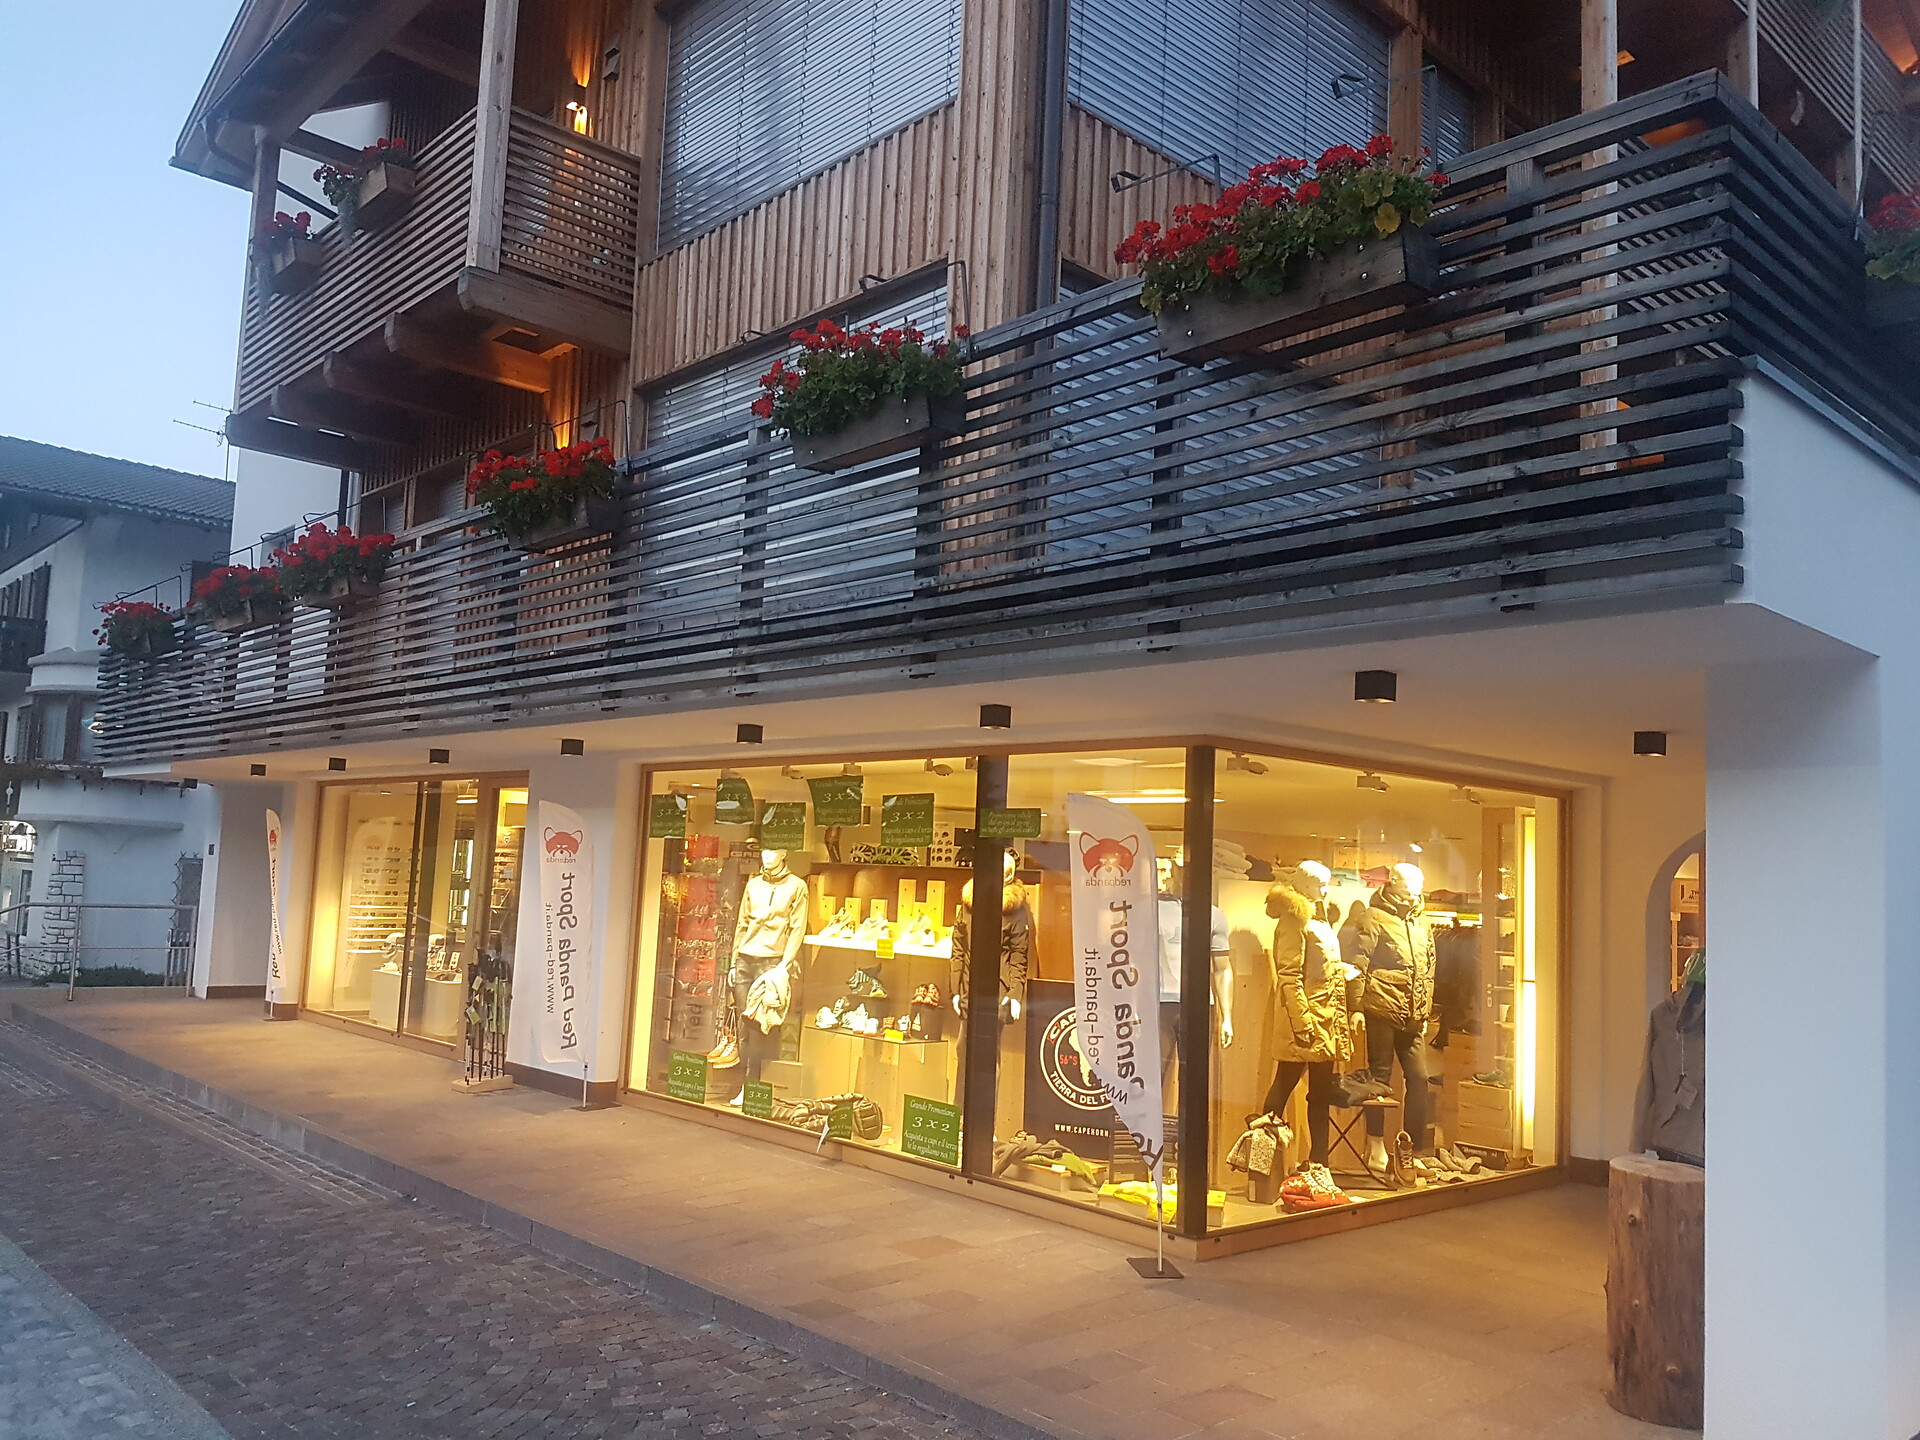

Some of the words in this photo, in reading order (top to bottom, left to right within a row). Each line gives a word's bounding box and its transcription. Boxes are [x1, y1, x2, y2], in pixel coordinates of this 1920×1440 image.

[725, 793, 731, 801] 3
[822, 792, 831, 803] 3
[656, 808, 664, 818] 3
[890, 811, 900, 823] 3
[916, 811, 925, 819] 2
[769, 818, 777, 828] 3
[673, 1065, 682, 1076] 3
[693, 1069, 700, 1078] 2
[1049, 1070, 1077, 1101] TIERRA
[1079, 1094, 1099, 1105] DEL
[748, 1090, 755, 1098] 3
[910, 1099, 927, 1111] Grande
[911, 1116, 923, 1128] 3
[940, 1123, 950, 1132] 2
